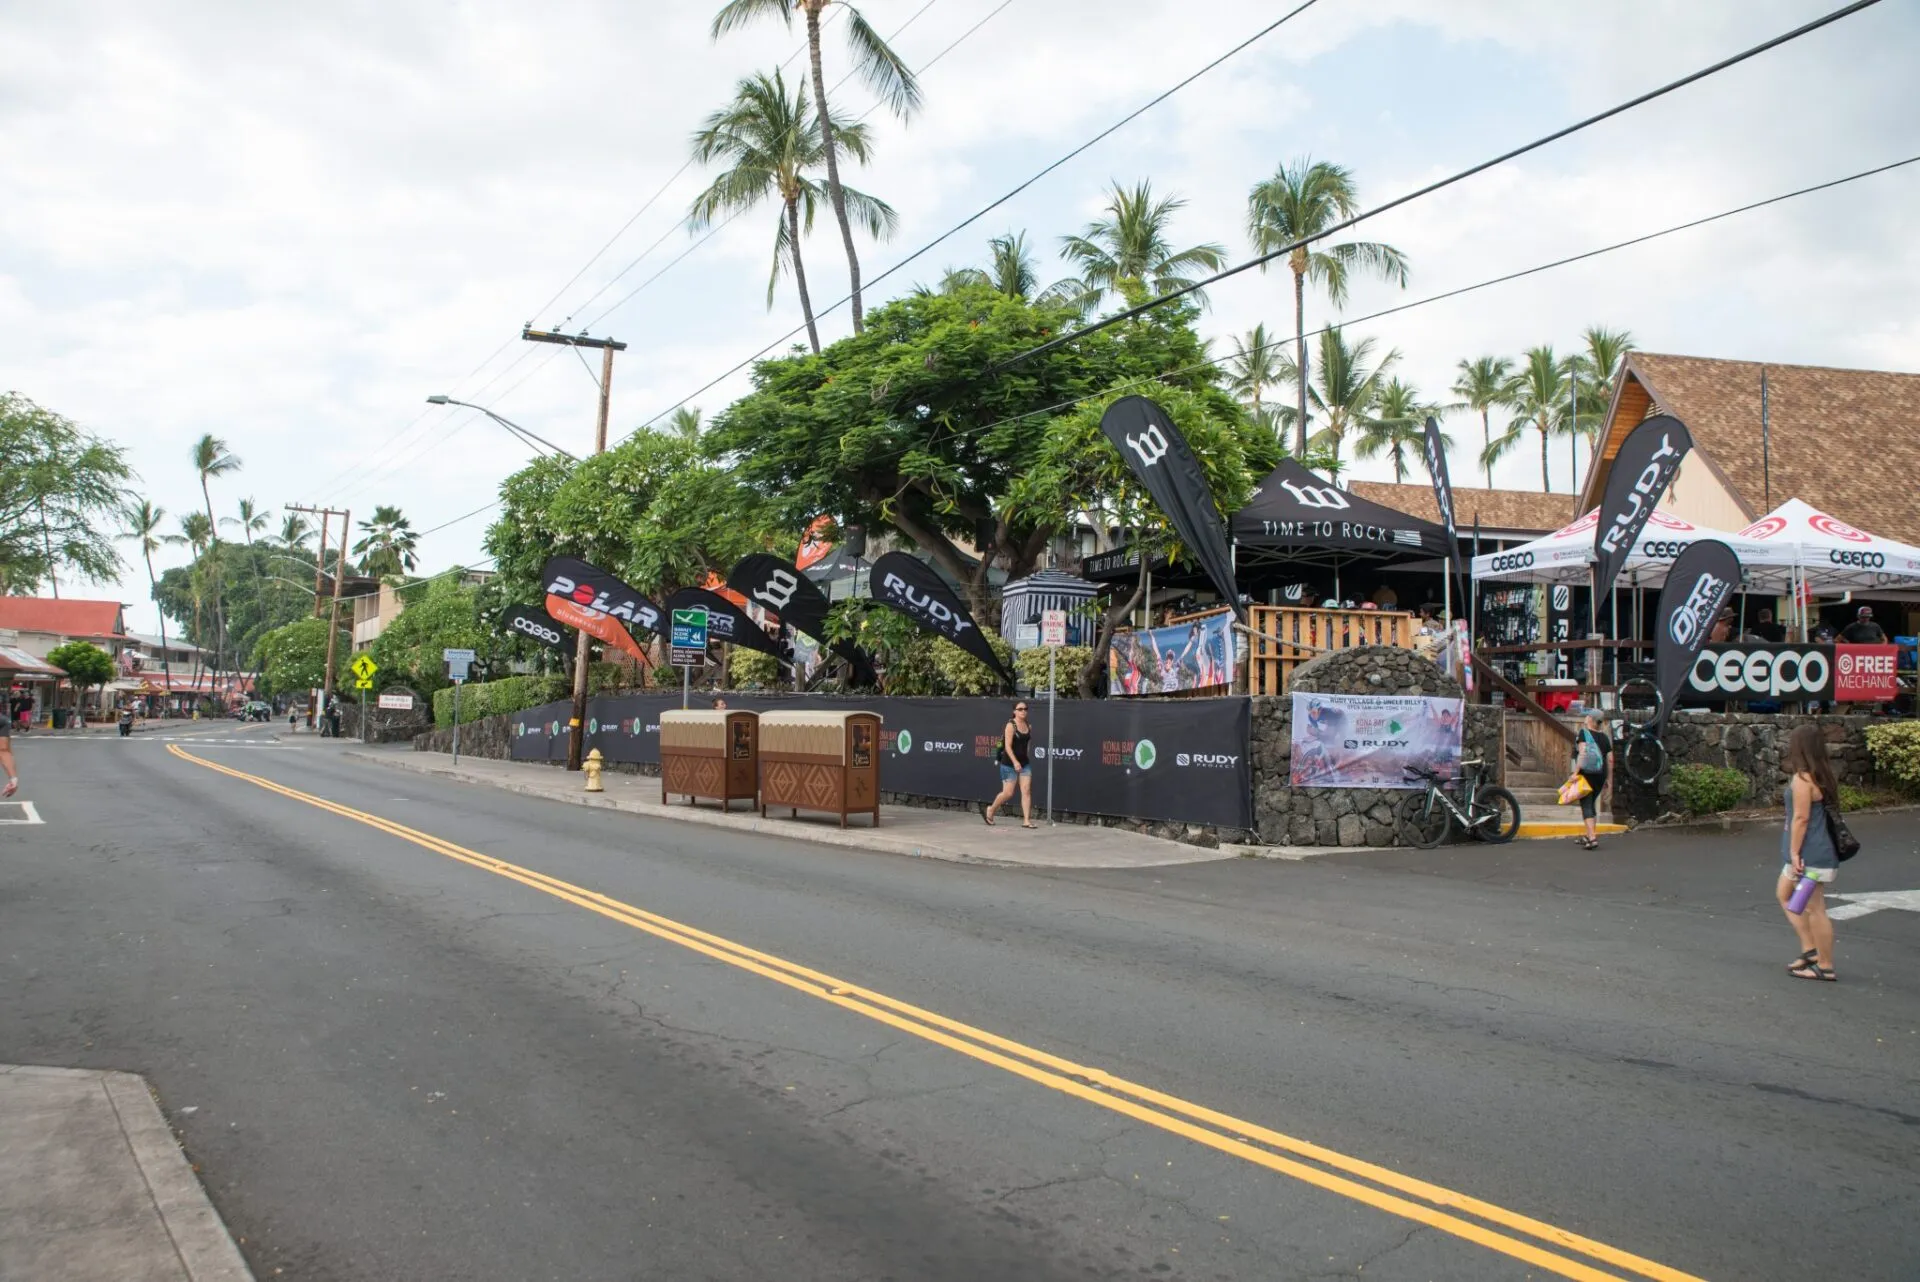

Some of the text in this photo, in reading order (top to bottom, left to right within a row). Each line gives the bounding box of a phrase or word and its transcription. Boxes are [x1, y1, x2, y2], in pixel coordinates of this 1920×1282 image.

[1601, 433, 1674, 553] RUDY
[1622, 449, 1680, 549] PROJECT
[1263, 520, 1387, 542] TIME TO ROCK
[546, 575, 659, 629] POLAR
[883, 572, 972, 632] RUDY
[886, 591, 959, 638] PROJECT
[1855, 656, 1894, 673] FREE
[1838, 675, 1896, 689] MECHANIC
[935, 741, 964, 750] RUDY
[1102, 740, 1135, 752] KONA BAY
[1102, 753, 1121, 765] HOTEL
[1193, 754, 1239, 764] RUDY
